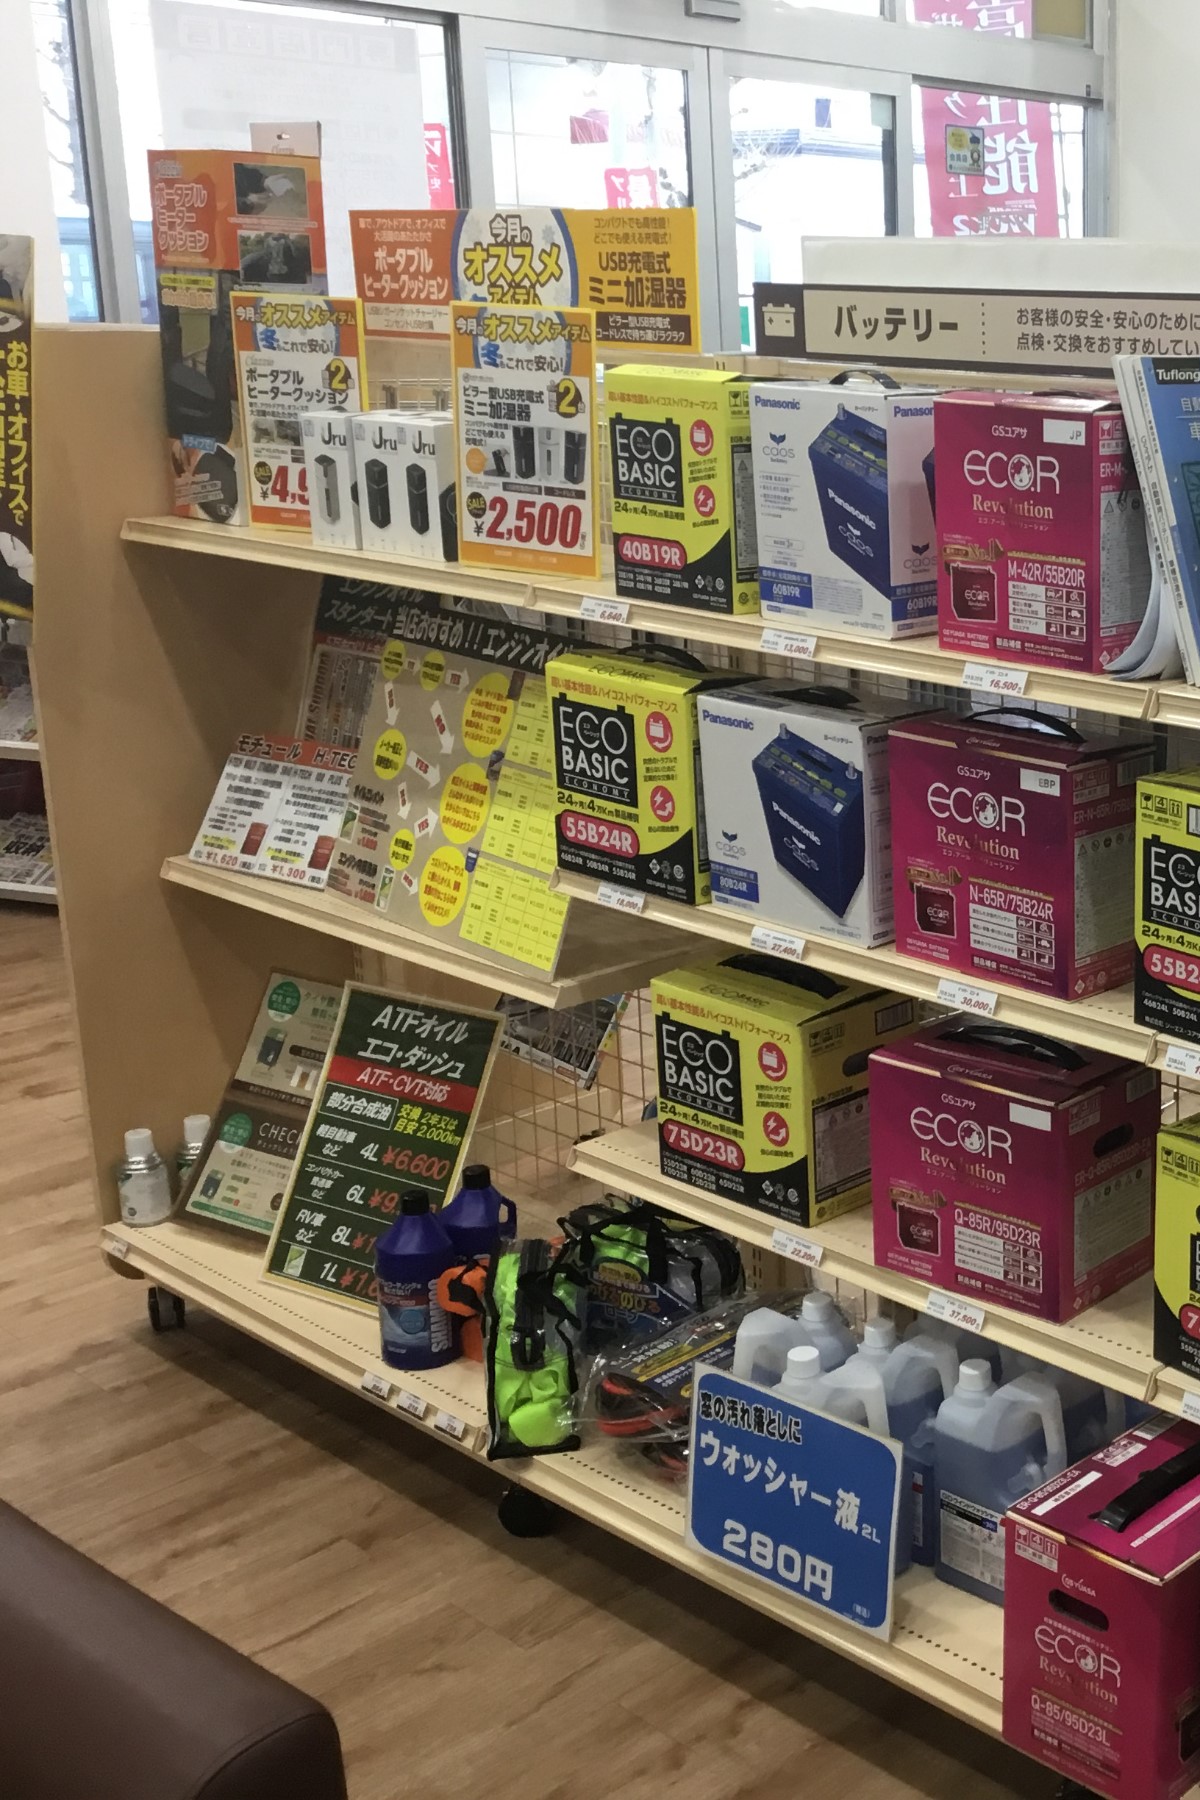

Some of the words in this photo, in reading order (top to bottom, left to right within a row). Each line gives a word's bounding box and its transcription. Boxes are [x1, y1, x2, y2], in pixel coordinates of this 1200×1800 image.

[155, 183, 207, 207] ポータブル
[156, 207, 196, 229] ヒーター
[490, 214, 532, 244] 今月の
[158, 231, 209, 252] クッション
[374, 248, 432, 274] ポータブル
[463, 243, 563, 287] オススメ
[599, 251, 670, 274] USB充電式
[364, 274, 448, 300] ヒータークッション
[589, 276, 686, 309] ミニ加湿器
[456, 313, 590, 344] 今月のオススメアイテム
[834, 305, 959, 343] バッテリー
[246, 368, 304, 384] ポータブル
[1156, 368, 1200, 383] Tuflong
[247, 387, 348, 404] ヒータークッション
[463, 386, 544, 404] ピラー型USB充電式
[755, 395, 800, 411] Panasonic
[464, 401, 531, 422] ミニ加湿器
[6, 340, 28, 526] お車・オフィスで
[615, 425, 674, 462] ECO
[992, 425, 1027, 439] GSユアサ
[618, 459, 676, 488] BASIC
[620, 486, 677, 501] ECONOMY
[828, 487, 876, 531] Panasonic
[622, 537, 681, 567] 40B19R
[1008, 561, 1085, 588] M-42R/55B20R
[772, 584, 800, 599] 60B19R
[989, 678, 1018, 692] 16,500
[559, 705, 627, 748] ECO
[702, 709, 754, 730] Panasonic
[237, 734, 302, 759] モチュール
[562, 746, 629, 785] BASIC
[957, 765, 991, 780] GSユアサ
[566, 817, 633, 854] 55B24R
[772, 801, 821, 846] Panasonic
[719, 876, 747, 893] 80B24R
[969, 883, 1054, 921] N-65R/75B24R
[960, 995, 989, 1011] 30,000
[1143, 998, 1168, 1013] 46B24L
[1172, 1007, 1198, 1022] 50B24L
[371, 1004, 469, 1045] ATFオイル
[358, 1037, 466, 1079] エコ・ダッシュ
[661, 1023, 733, 1075] ECO
[356, 1067, 451, 1103] ATF・CVT対応
[665, 1059, 734, 1103] BASIC
[326, 1091, 393, 1122] 部分合成油
[941, 1093, 976, 1111] GSユアサ
[667, 1123, 738, 1167] 75D23R
[345, 1185, 364, 1206] 6L
[331, 1225, 351, 1246] 8L
[954, 1208, 1041, 1249] Q-85R/95D23R
[949, 1308, 977, 1326] 37,500
[700, 1389, 802, 1445] 窓の汚れ落としに
[861, 1523, 881, 1544] 2L
[722, 1518, 833, 1601] 280円
[1031, 1694, 1111, 1747] Q-85/95D23L
